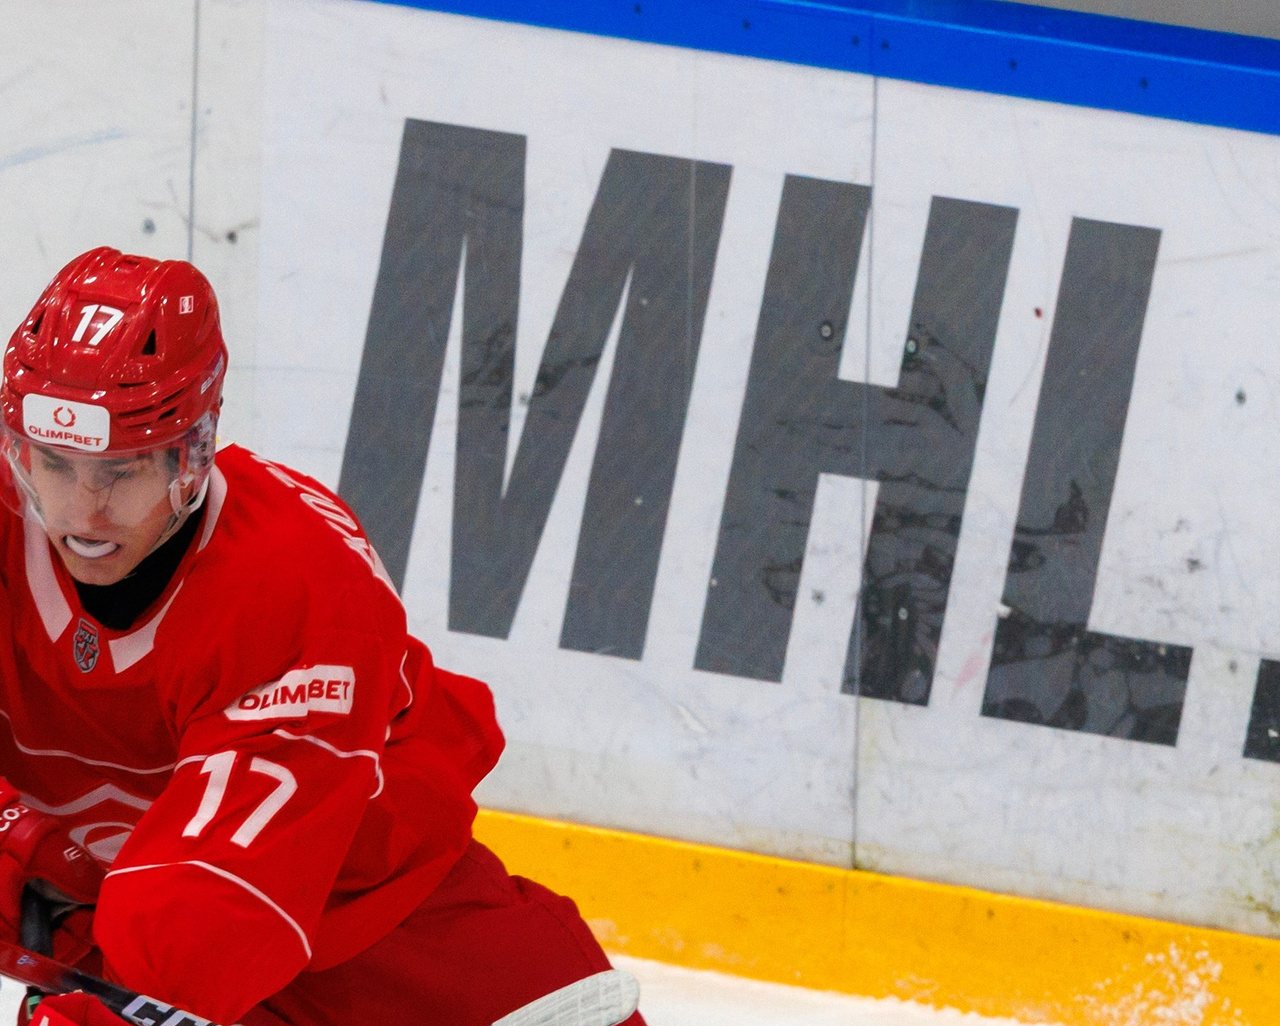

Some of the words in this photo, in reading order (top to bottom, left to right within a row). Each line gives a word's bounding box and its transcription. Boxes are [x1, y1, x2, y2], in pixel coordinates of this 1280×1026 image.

[72, 303, 124, 347] 17
[28, 424, 103, 448] OLIMPBET
[238, 678, 351, 712] OLIMBET
[181, 749, 299, 849] 17
